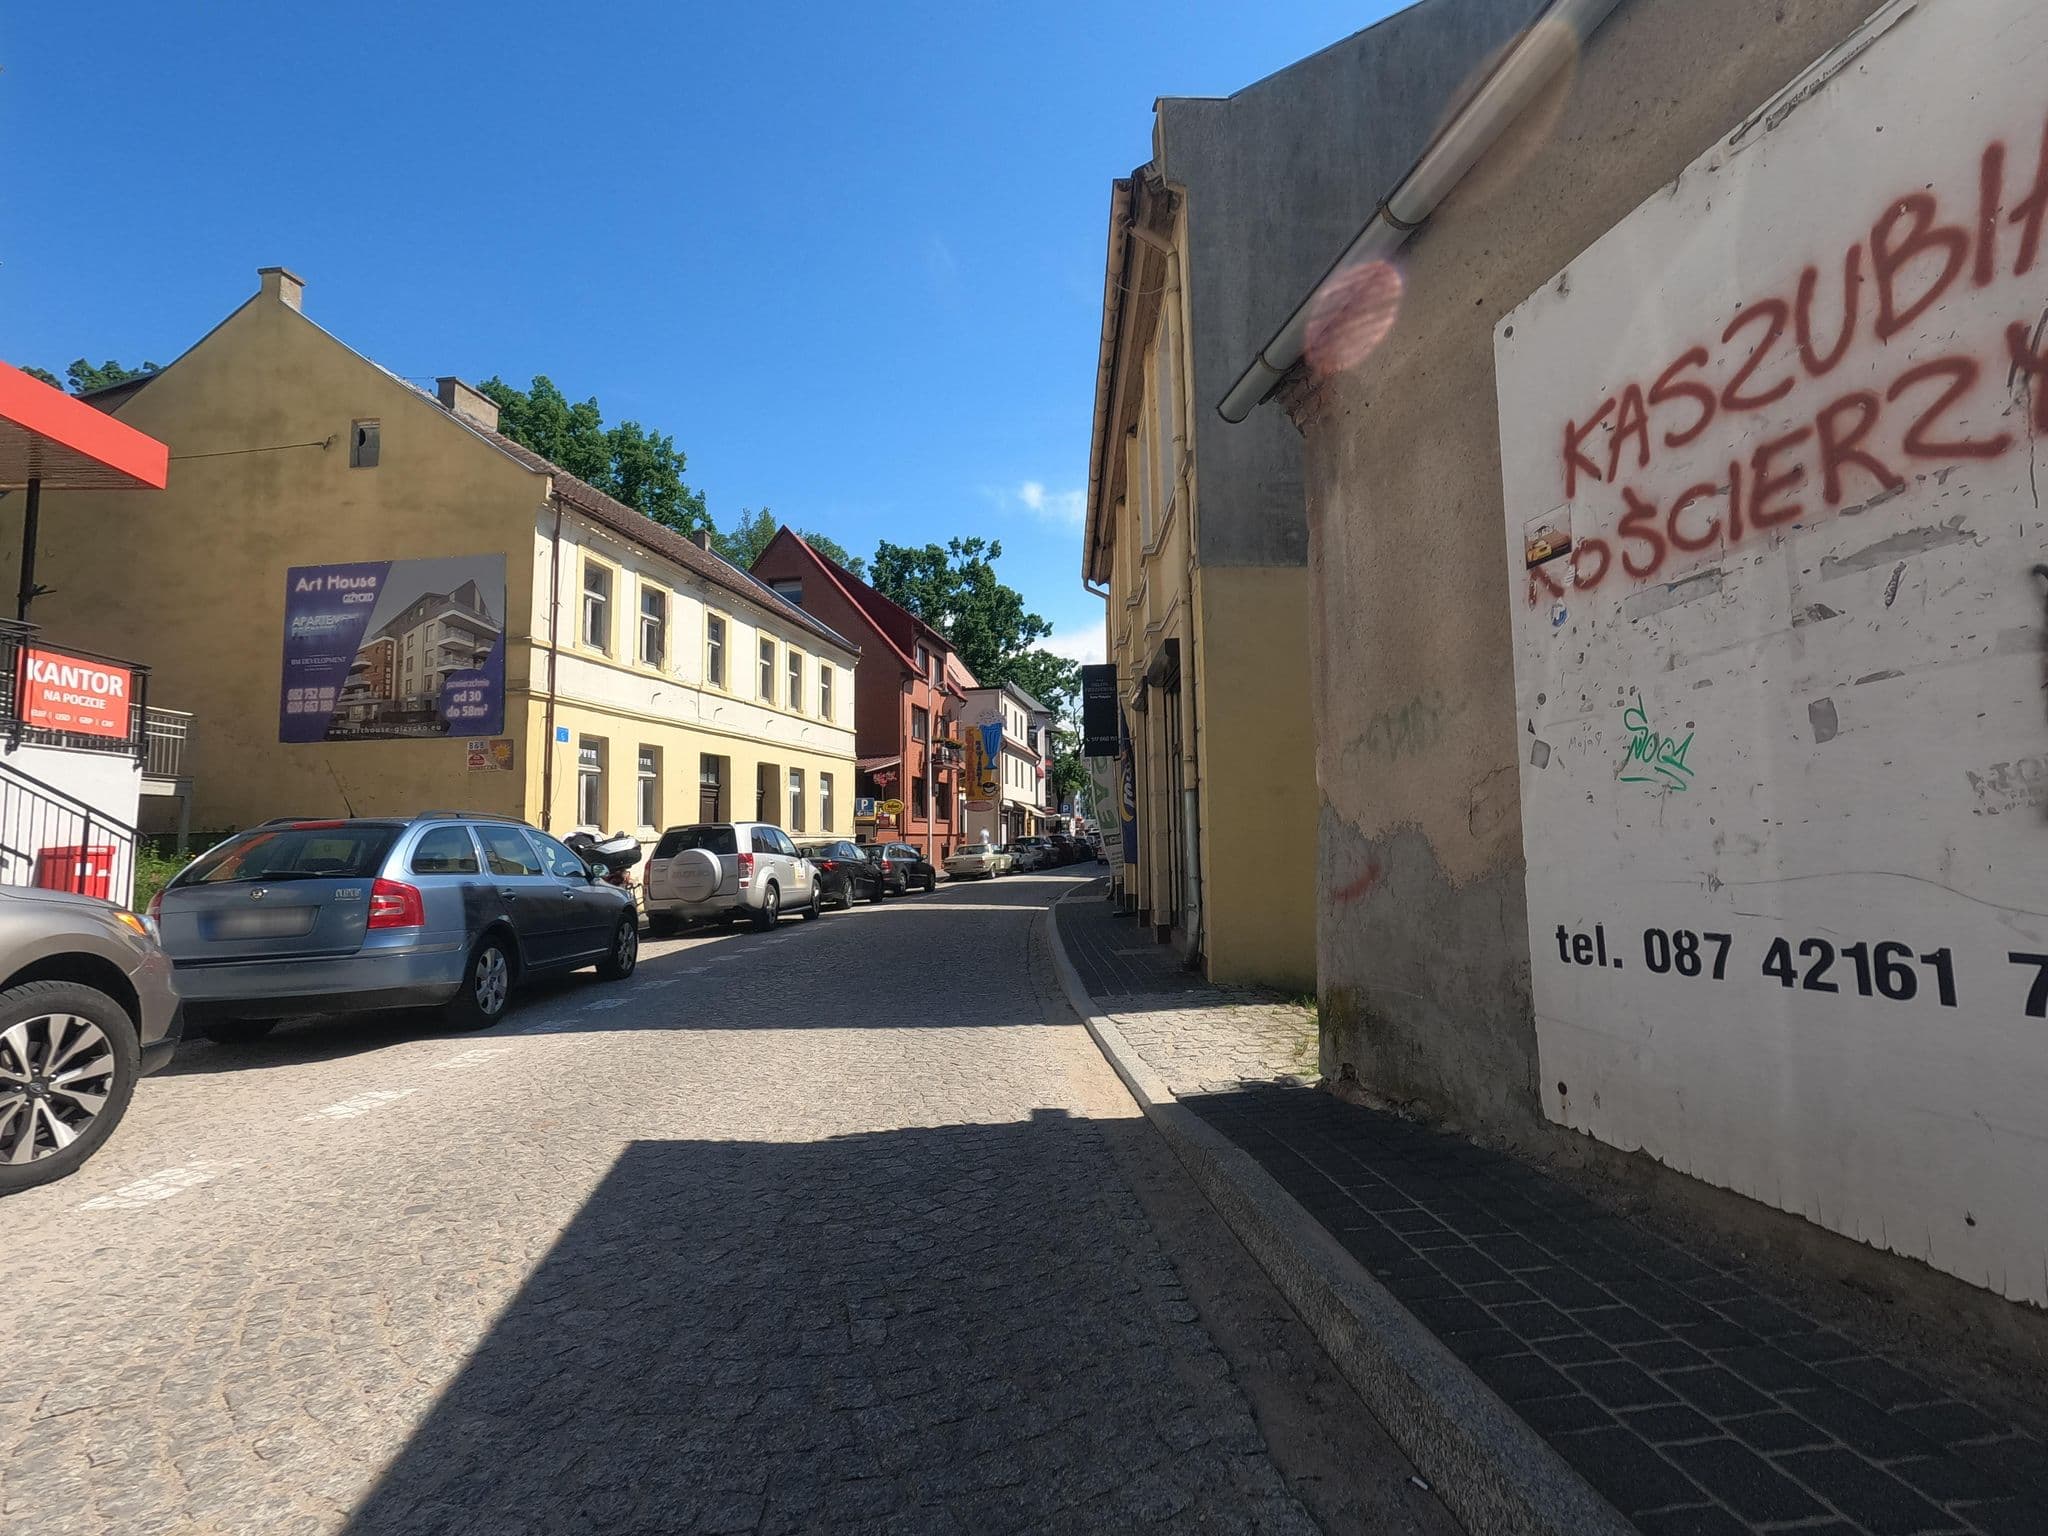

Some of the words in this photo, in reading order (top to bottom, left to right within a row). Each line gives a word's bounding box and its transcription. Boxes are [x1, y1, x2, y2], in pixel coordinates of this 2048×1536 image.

[295, 577, 322, 592] Art
[327, 575, 377, 590] House
[27, 657, 123, 697] KANTOR
[43, 688, 61, 702] NA
[63, 692, 107, 710] POCZCIE
[453, 691, 467, 703] od
[470, 690, 482, 702] 30
[445, 706, 460, 718] do
[861, 799, 869, 810] P
[1556, 922, 1623, 969] tel.
[1643, 928, 1732, 980] 087
[1761, 936, 1957, 1008] 42161
